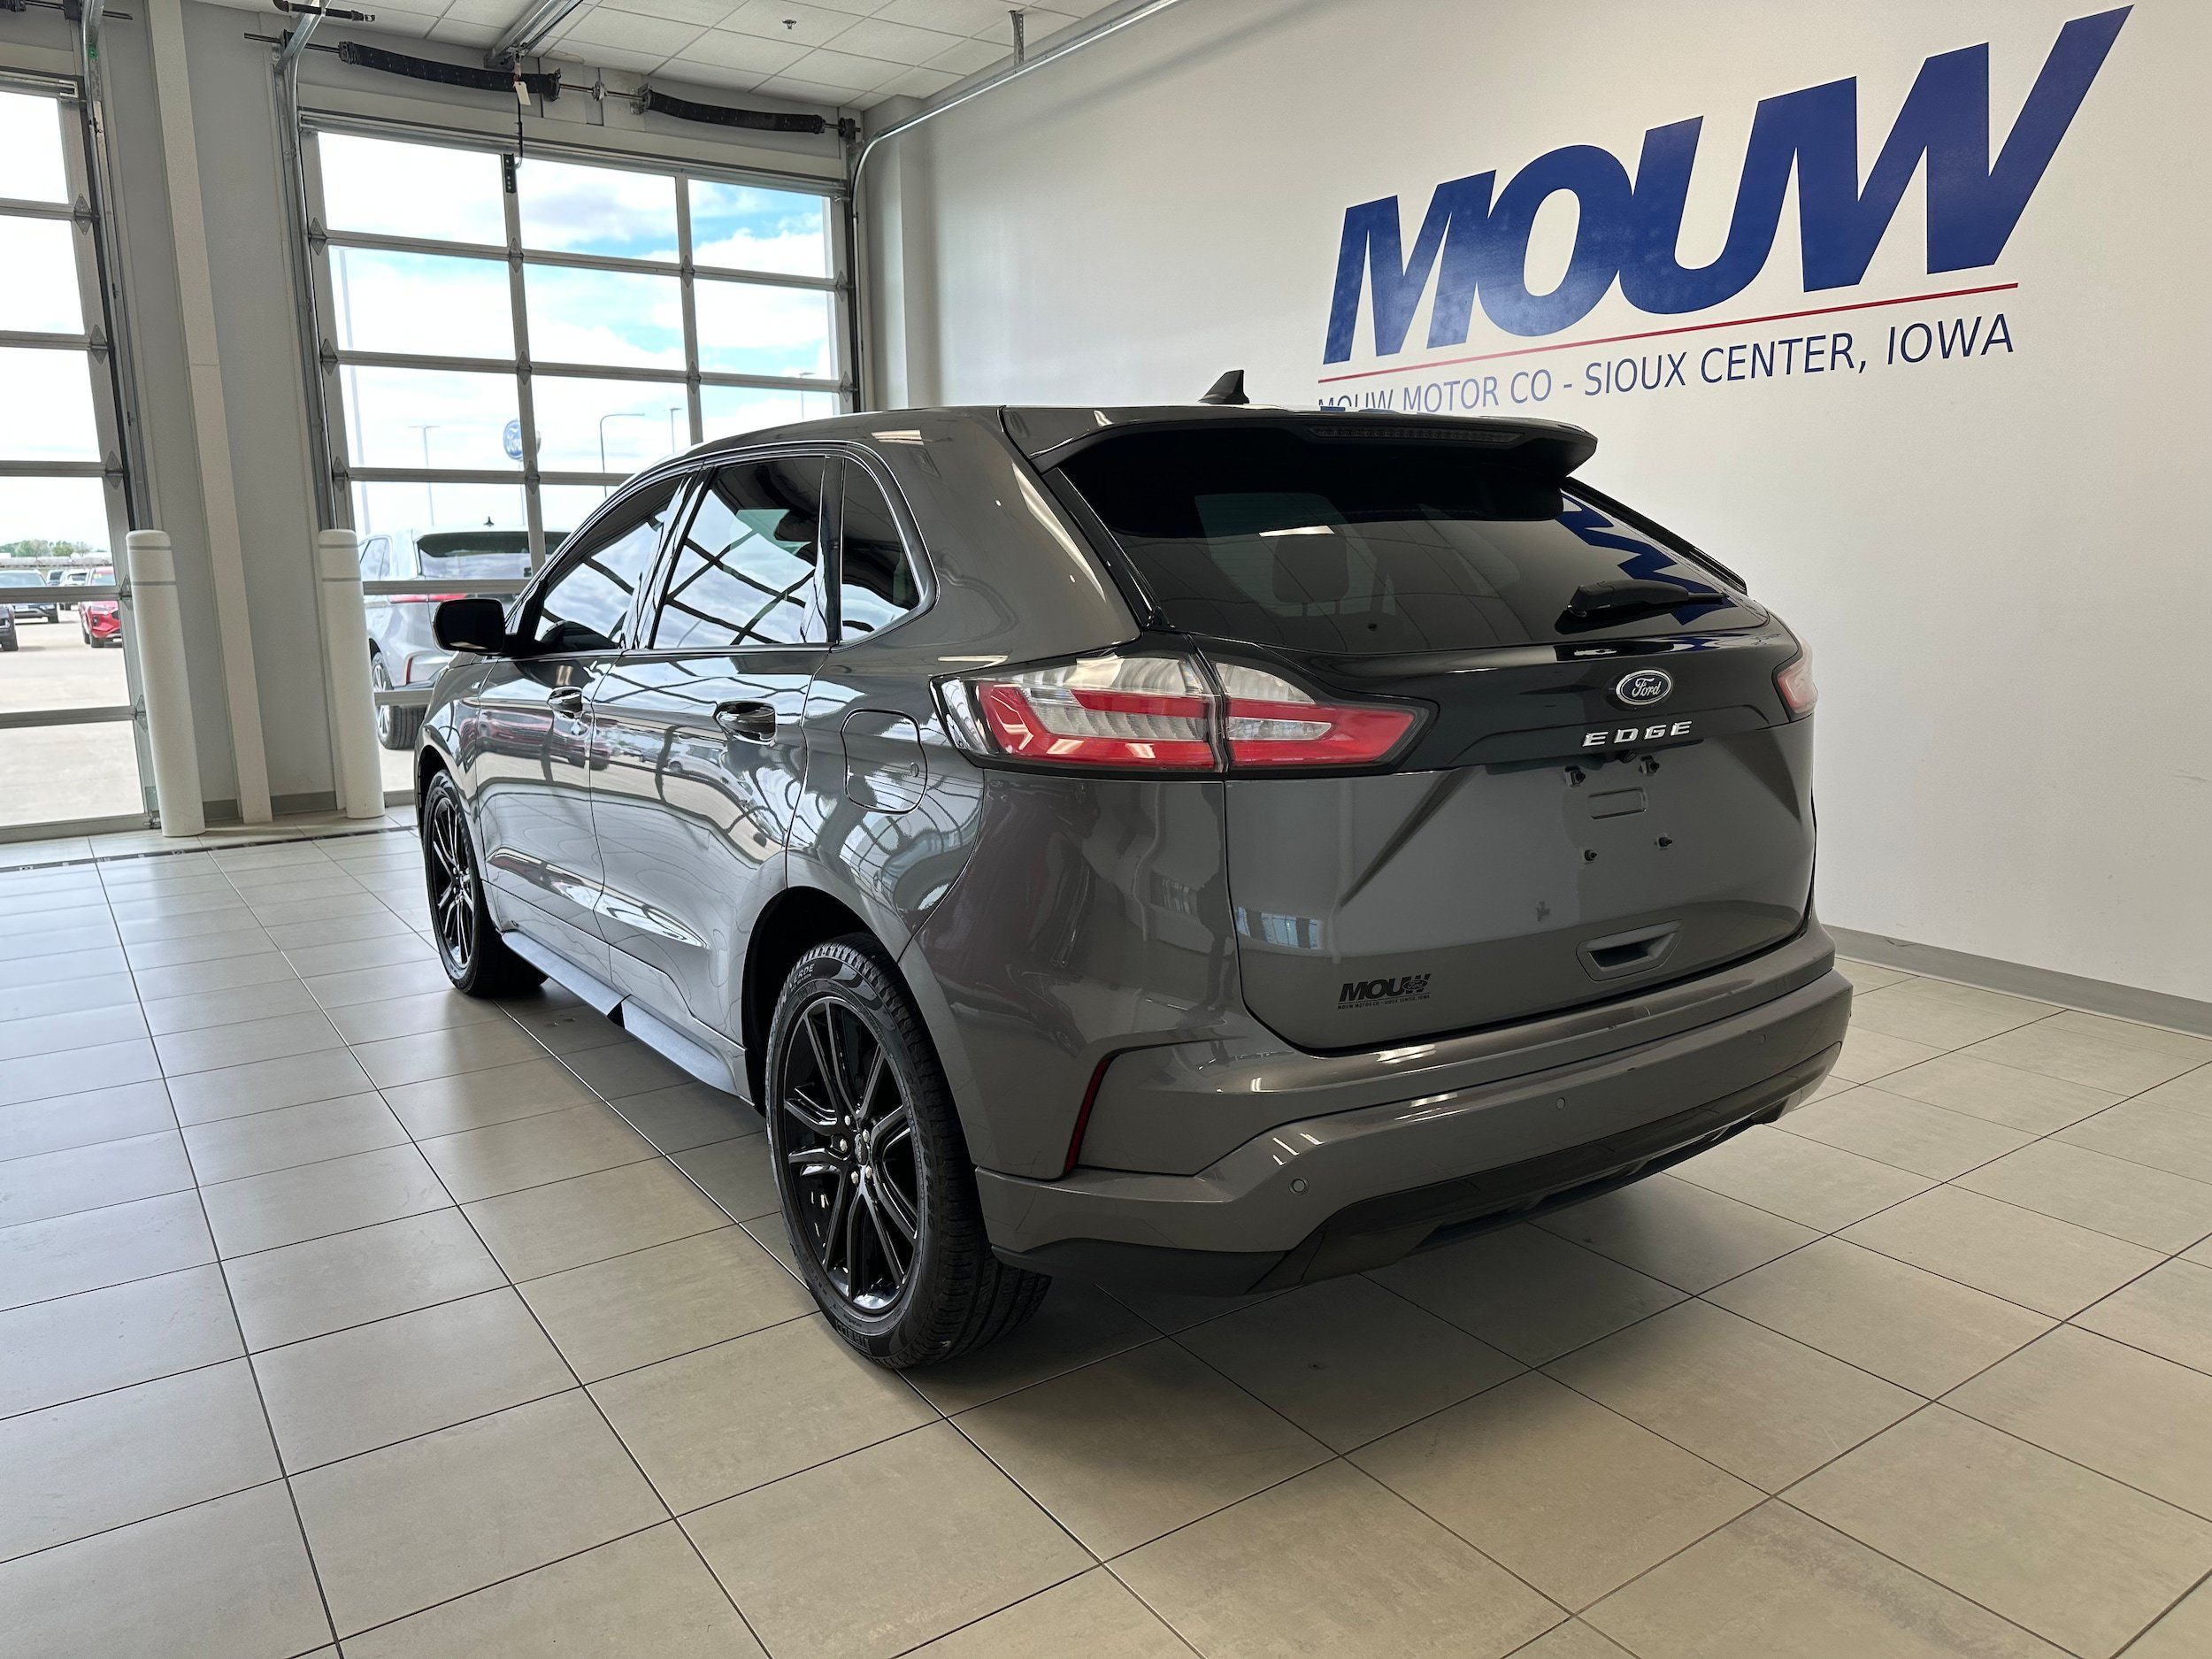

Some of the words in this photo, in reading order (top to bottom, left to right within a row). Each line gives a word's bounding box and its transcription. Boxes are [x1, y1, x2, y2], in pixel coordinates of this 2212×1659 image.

[1322, 6, 2132, 365] MOUW
[1402, 376, 1500, 413] MOTOR
[1509, 369, 1553, 404] CO
[1584, 351, 1687, 396] SIOUX
[1700, 332, 1868, 383] CENTER,
[1886, 313, 2014, 365] IOWA
[1632, 677, 1661, 697] Ford
[1582, 720, 1692, 747] EDGE
